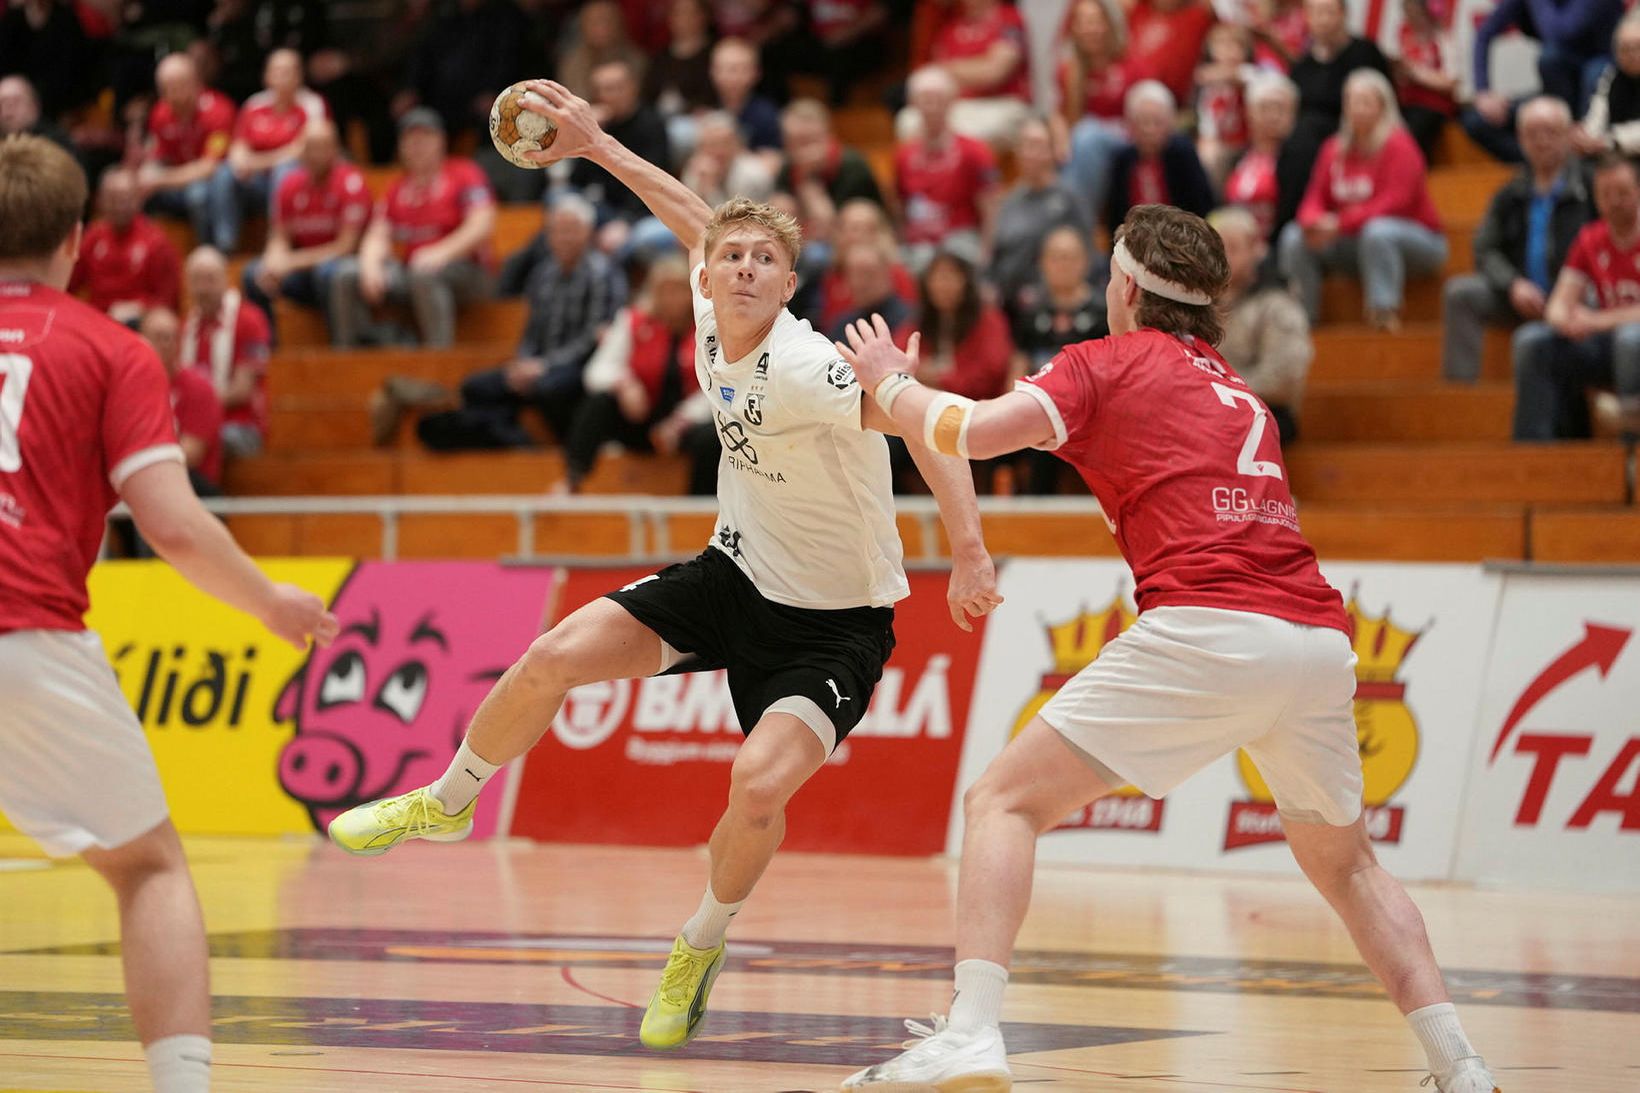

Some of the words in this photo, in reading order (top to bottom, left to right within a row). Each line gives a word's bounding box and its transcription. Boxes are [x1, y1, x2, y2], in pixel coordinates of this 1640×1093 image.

[1210, 381, 1283, 481] 2
[1212, 487, 1249, 512] GG
[137, 644, 258, 728] liði
[1513, 730, 1640, 832] TA
